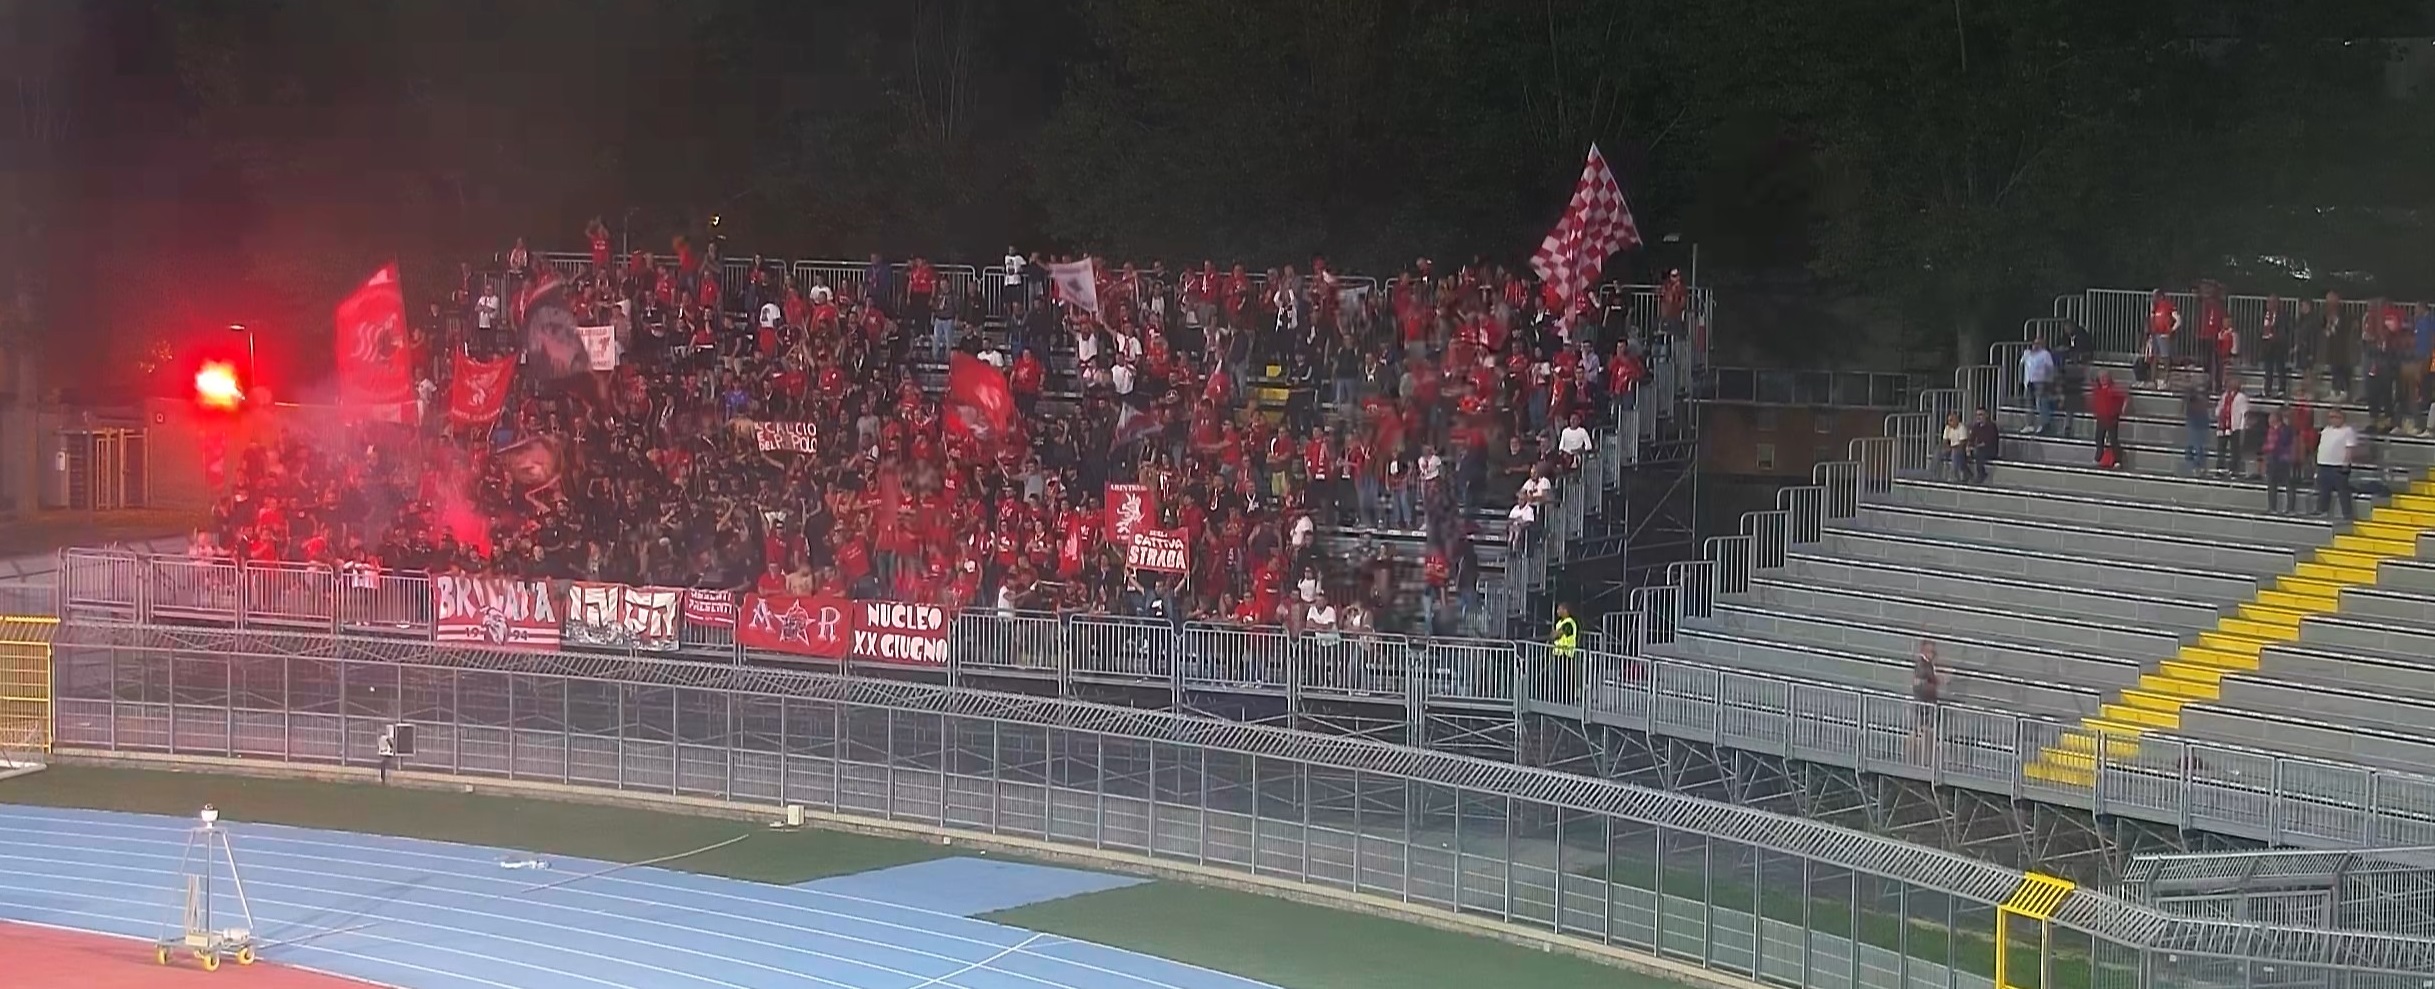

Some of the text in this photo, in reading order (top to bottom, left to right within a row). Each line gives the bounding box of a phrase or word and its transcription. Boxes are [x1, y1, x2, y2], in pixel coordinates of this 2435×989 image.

[1134, 533, 1184, 550] CATTIVA
[1128, 544, 1187, 569] STRADA
[689, 599, 733, 614] PRESENTI
[867, 602, 942, 631] NUCLEO
[748, 597, 841, 644] A R
[465, 627, 529, 641] 19 94
[853, 630, 948, 663] XX GIUGNO
